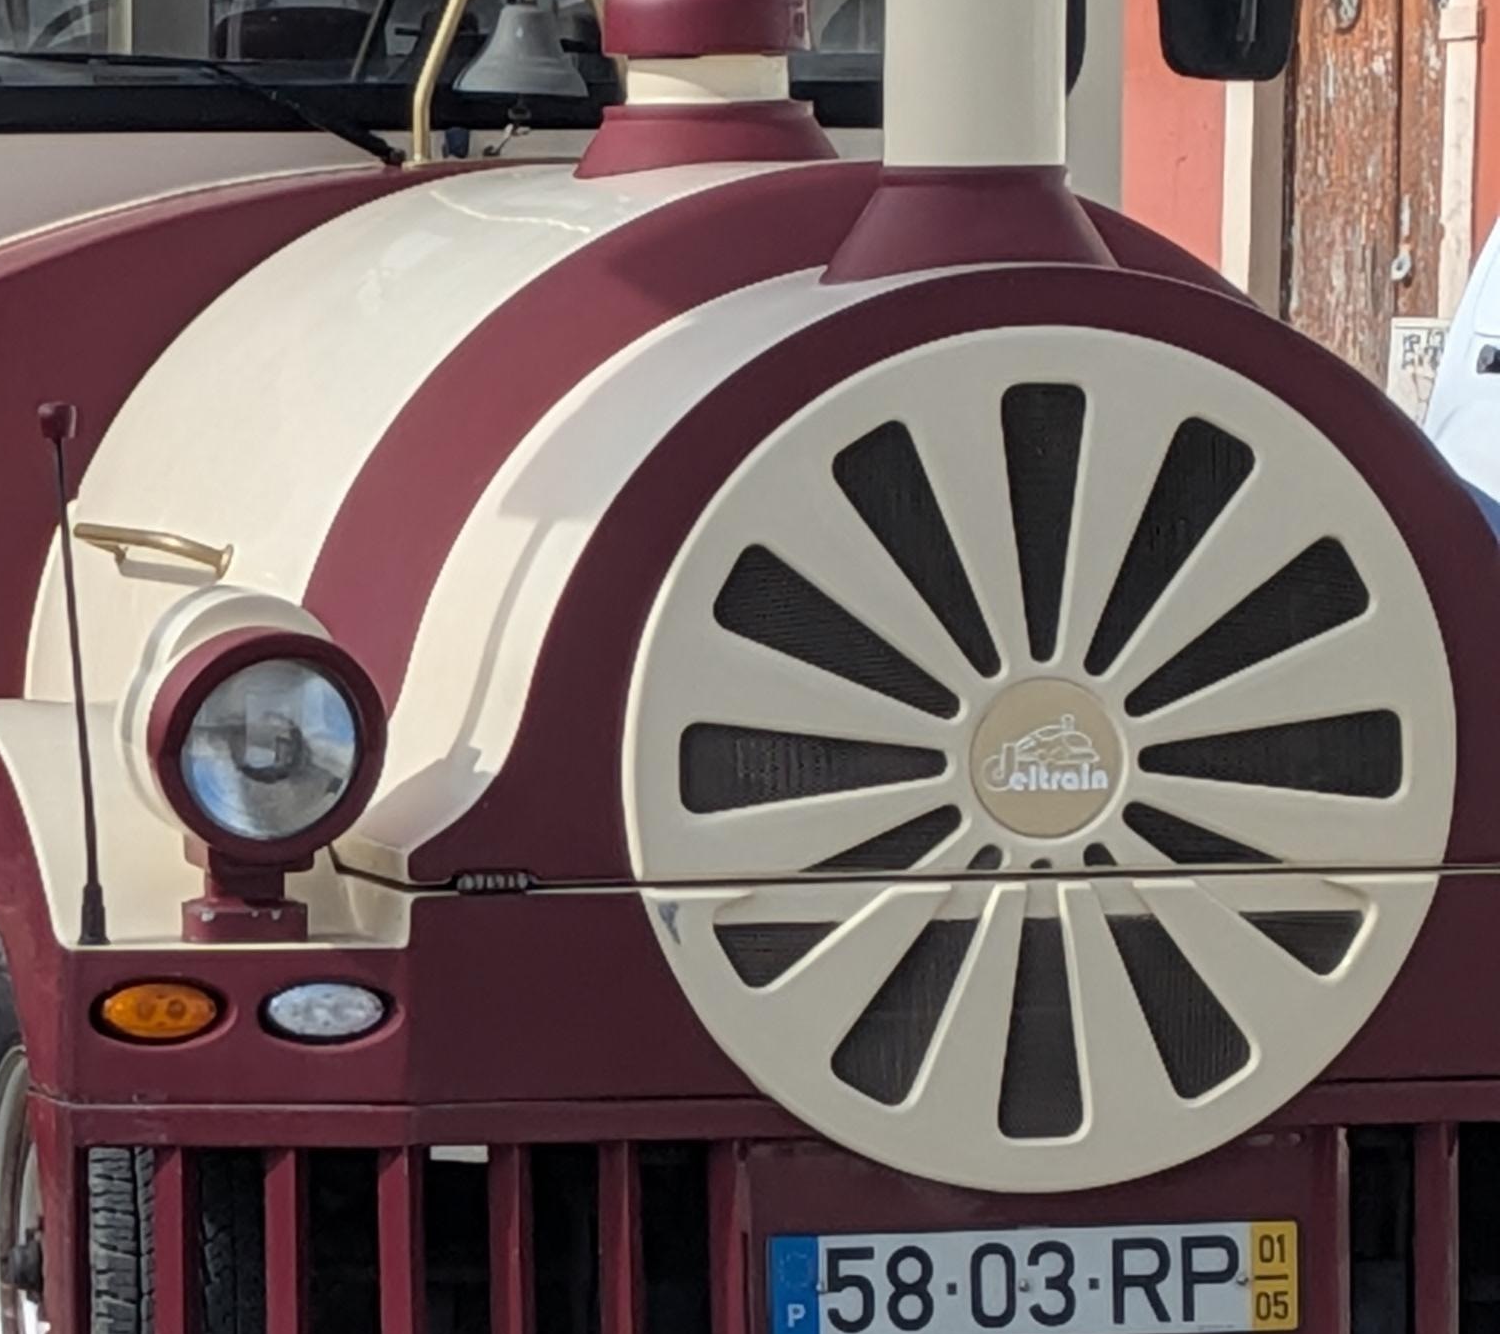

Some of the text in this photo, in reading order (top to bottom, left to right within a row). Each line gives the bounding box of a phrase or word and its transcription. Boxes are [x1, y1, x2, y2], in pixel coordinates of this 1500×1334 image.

[1258, 1234, 1288, 1264] 01
[788, 1304, 807, 1328] P
[1255, 1291, 1289, 1321] 05
